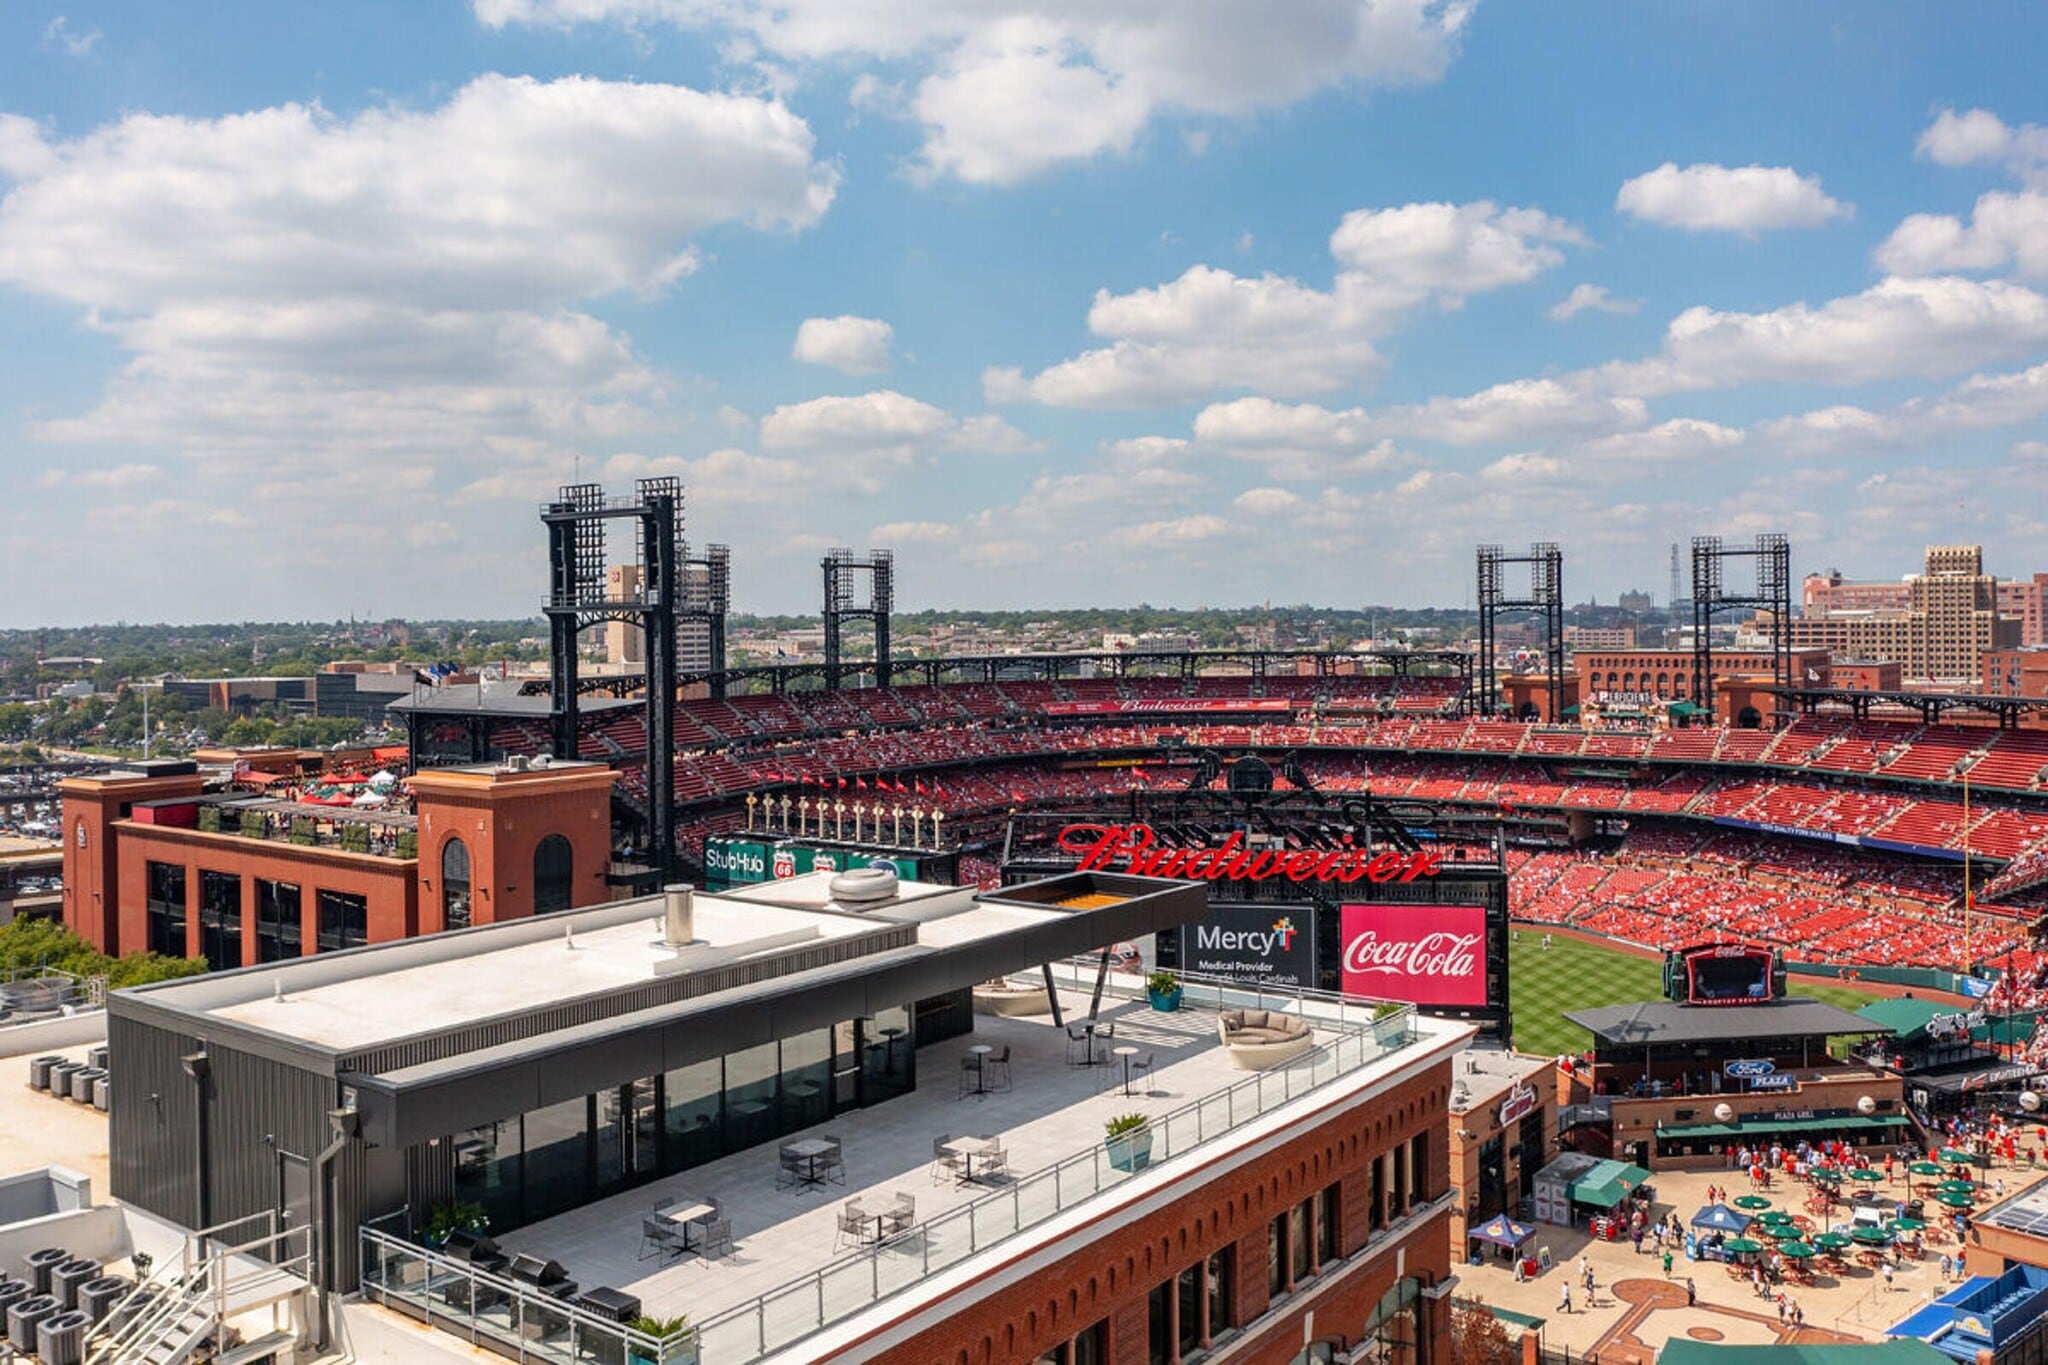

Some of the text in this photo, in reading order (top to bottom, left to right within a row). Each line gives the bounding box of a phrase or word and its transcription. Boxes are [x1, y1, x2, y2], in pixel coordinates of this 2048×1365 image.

[1113, 699, 1212, 712] Budweiser
[1058, 823, 1441, 883] Budweiser
[706, 849, 764, 873] StubHub
[777, 863, 791, 876] 66
[1197, 925, 1276, 956] Mercy
[1343, 930, 1483, 977] Coca-Cola
[1198, 960, 1274, 972] Medical Provider
[1736, 1063, 1765, 1076] Ford
[1755, 1075, 1790, 1087] PLAZA
[1774, 1111, 1795, 1120] PLAZA
